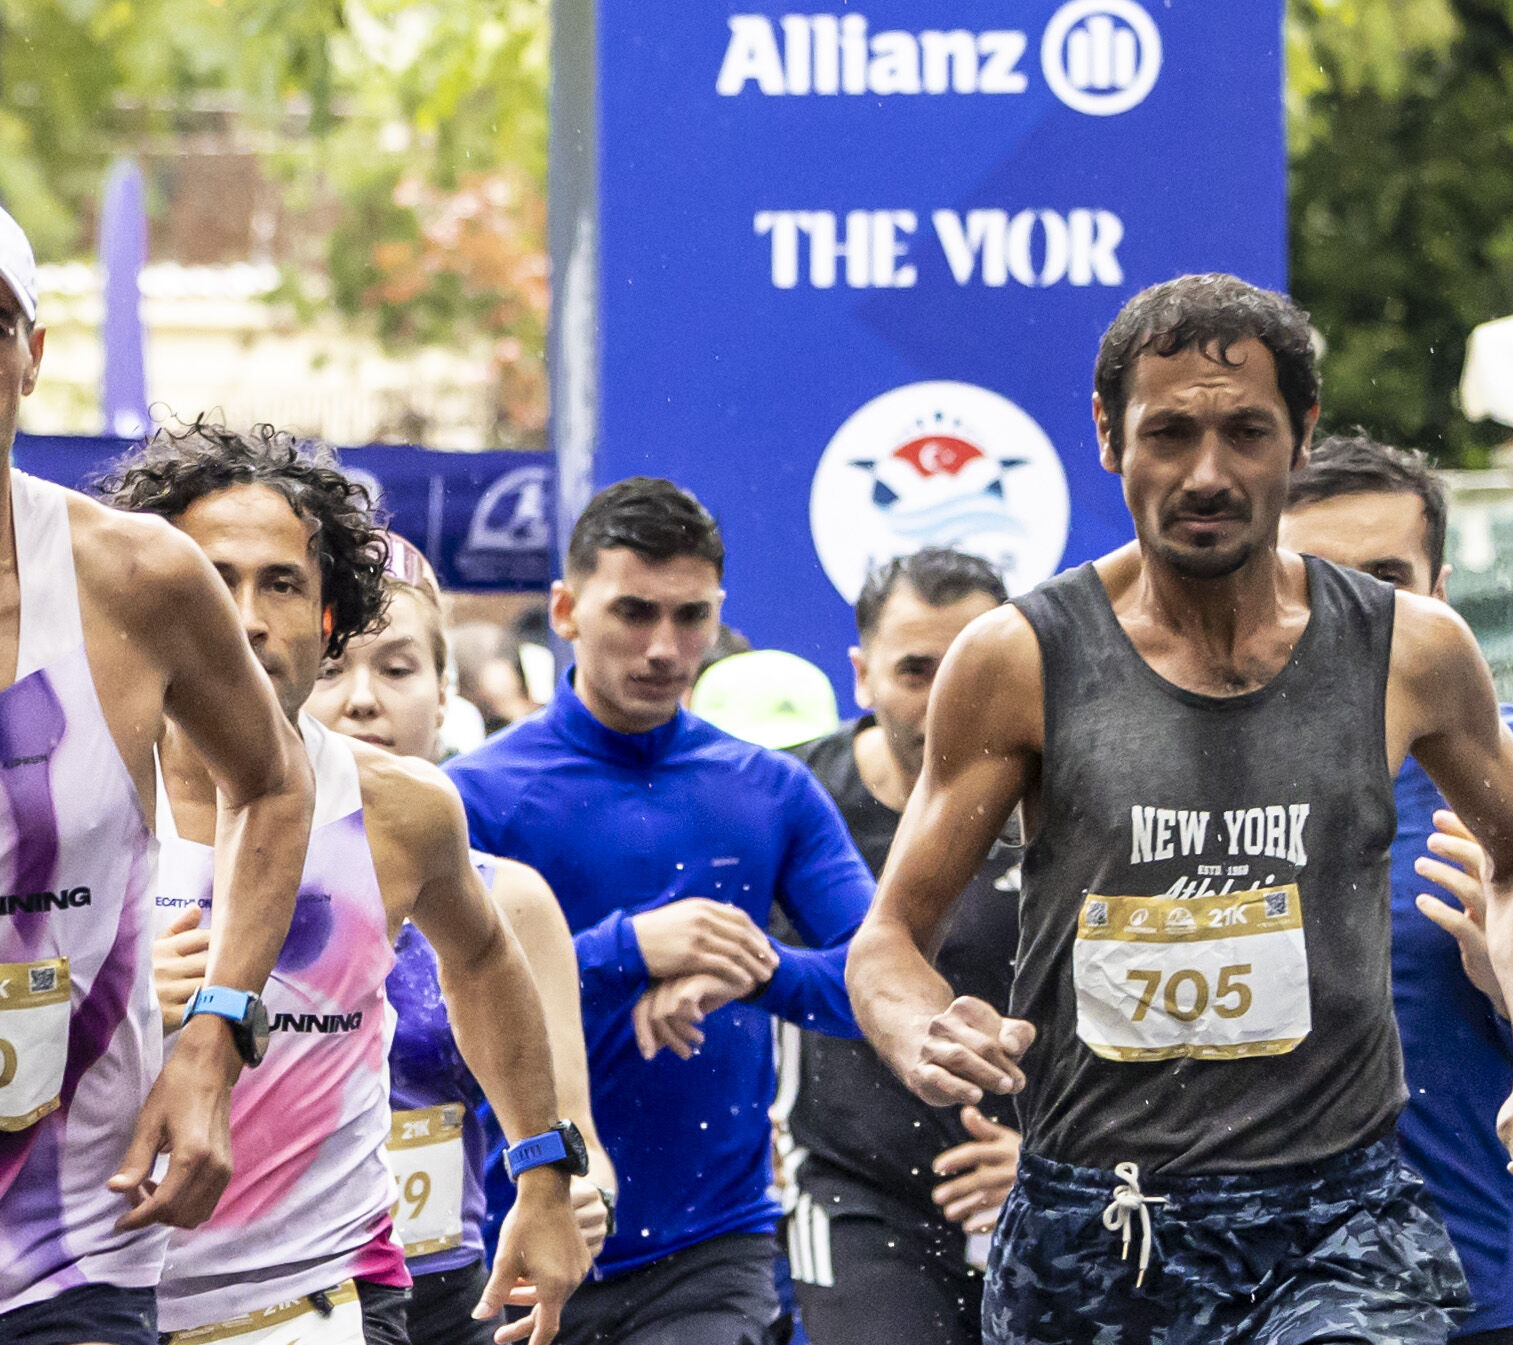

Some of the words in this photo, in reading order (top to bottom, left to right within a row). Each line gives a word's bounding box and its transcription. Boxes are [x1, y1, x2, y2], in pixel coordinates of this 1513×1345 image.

[716, 13, 1027, 96] Allianz
[753, 209, 917, 289] THE
[932, 208, 1124, 287] VIOR
[1131, 805, 1211, 864] NEW
[1223, 803, 1310, 867] YORK
[1207, 908, 1249, 929] 21K
[1126, 963, 1253, 1023] 705
[401, 1119, 431, 1140] 21K
